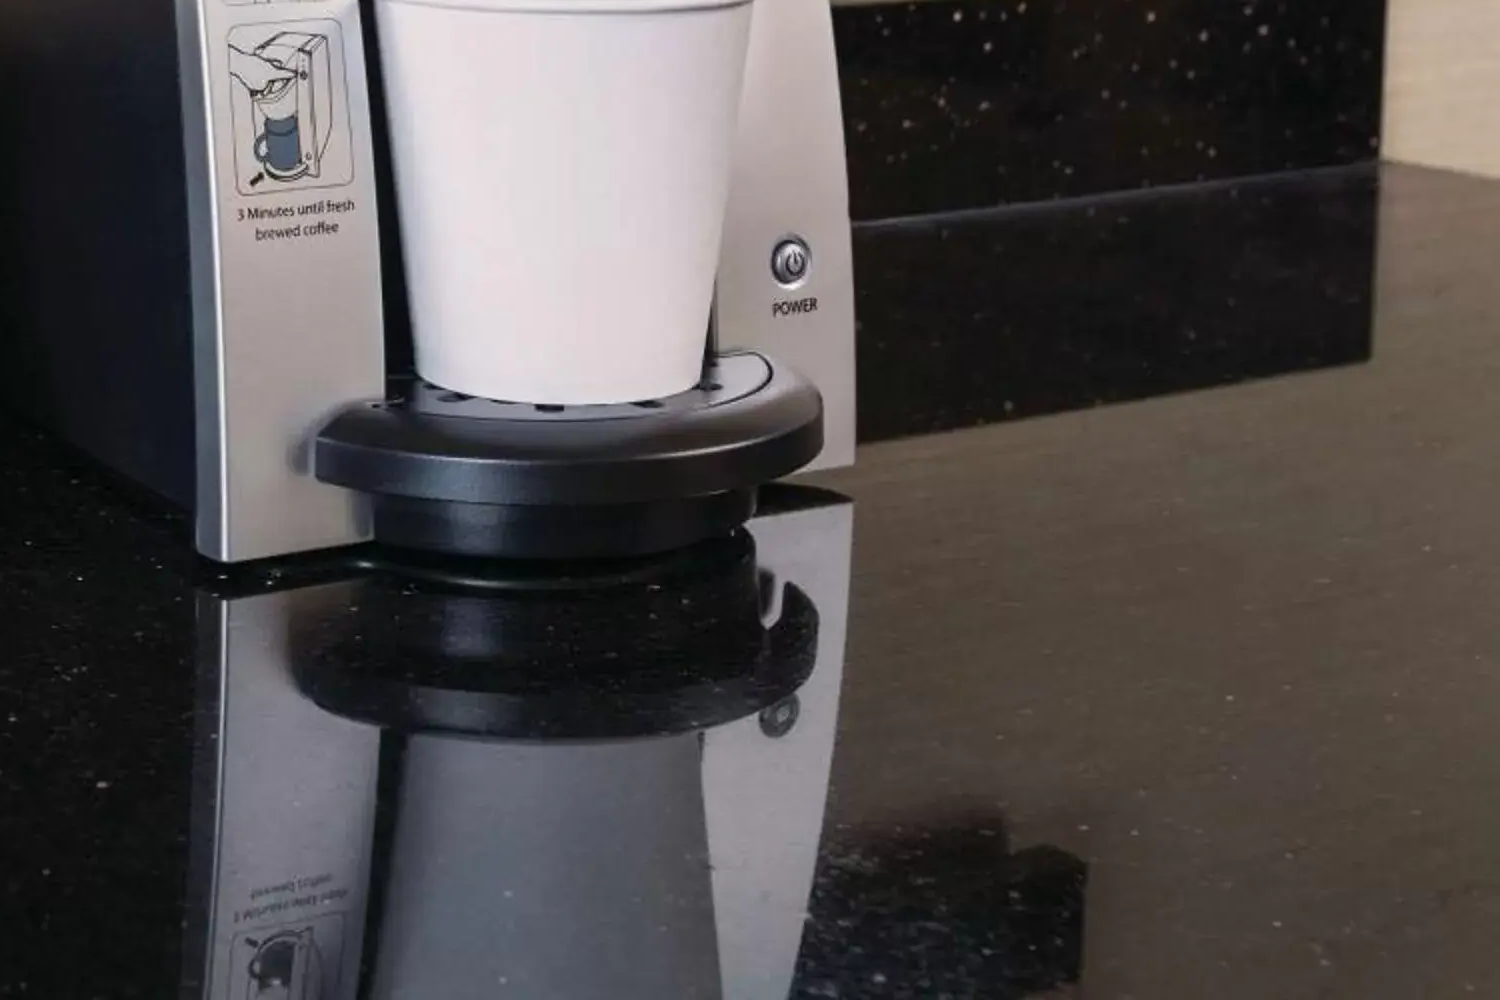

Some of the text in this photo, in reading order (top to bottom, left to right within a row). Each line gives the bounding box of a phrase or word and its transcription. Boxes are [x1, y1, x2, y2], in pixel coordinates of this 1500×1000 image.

[237, 199, 355, 222] 3 Minutes until fresh
[255, 221, 340, 241] brewed coffee
[771, 297, 818, 318] POWER
